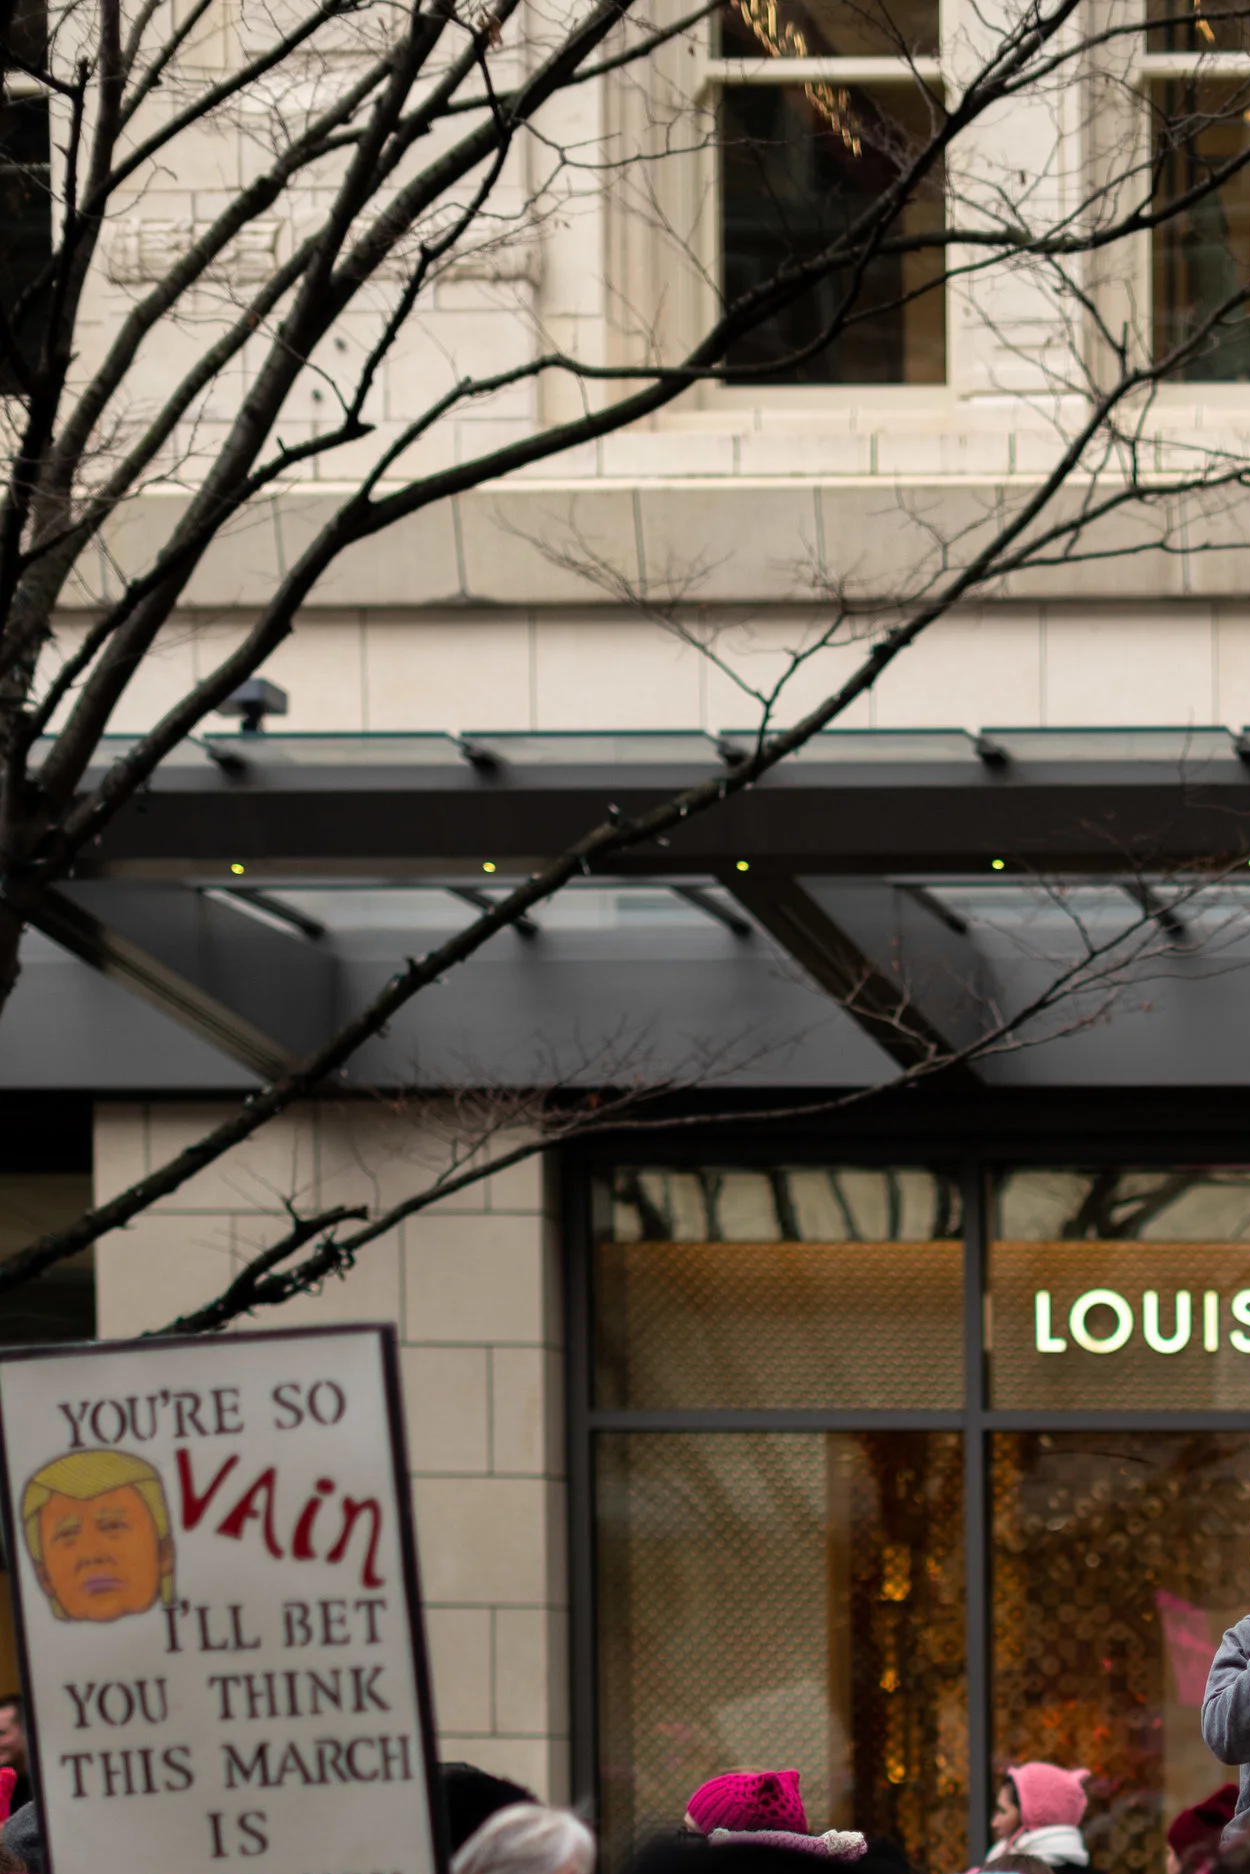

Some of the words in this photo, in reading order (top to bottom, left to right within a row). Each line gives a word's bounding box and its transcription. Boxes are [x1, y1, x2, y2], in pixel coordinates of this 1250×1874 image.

[57, 1388, 244, 1451] YOU'RE
[271, 1380, 346, 1430] SO
[163, 1602, 261, 1653] I'LL
[283, 1598, 386, 1648] BET
[64, 1677, 168, 1729] YOU
[208, 1666, 390, 1721] THINK
[60, 1745, 195, 1798] THIS
[222, 1735, 412, 1789] MARCH
[207, 1811, 269, 1859] IS
